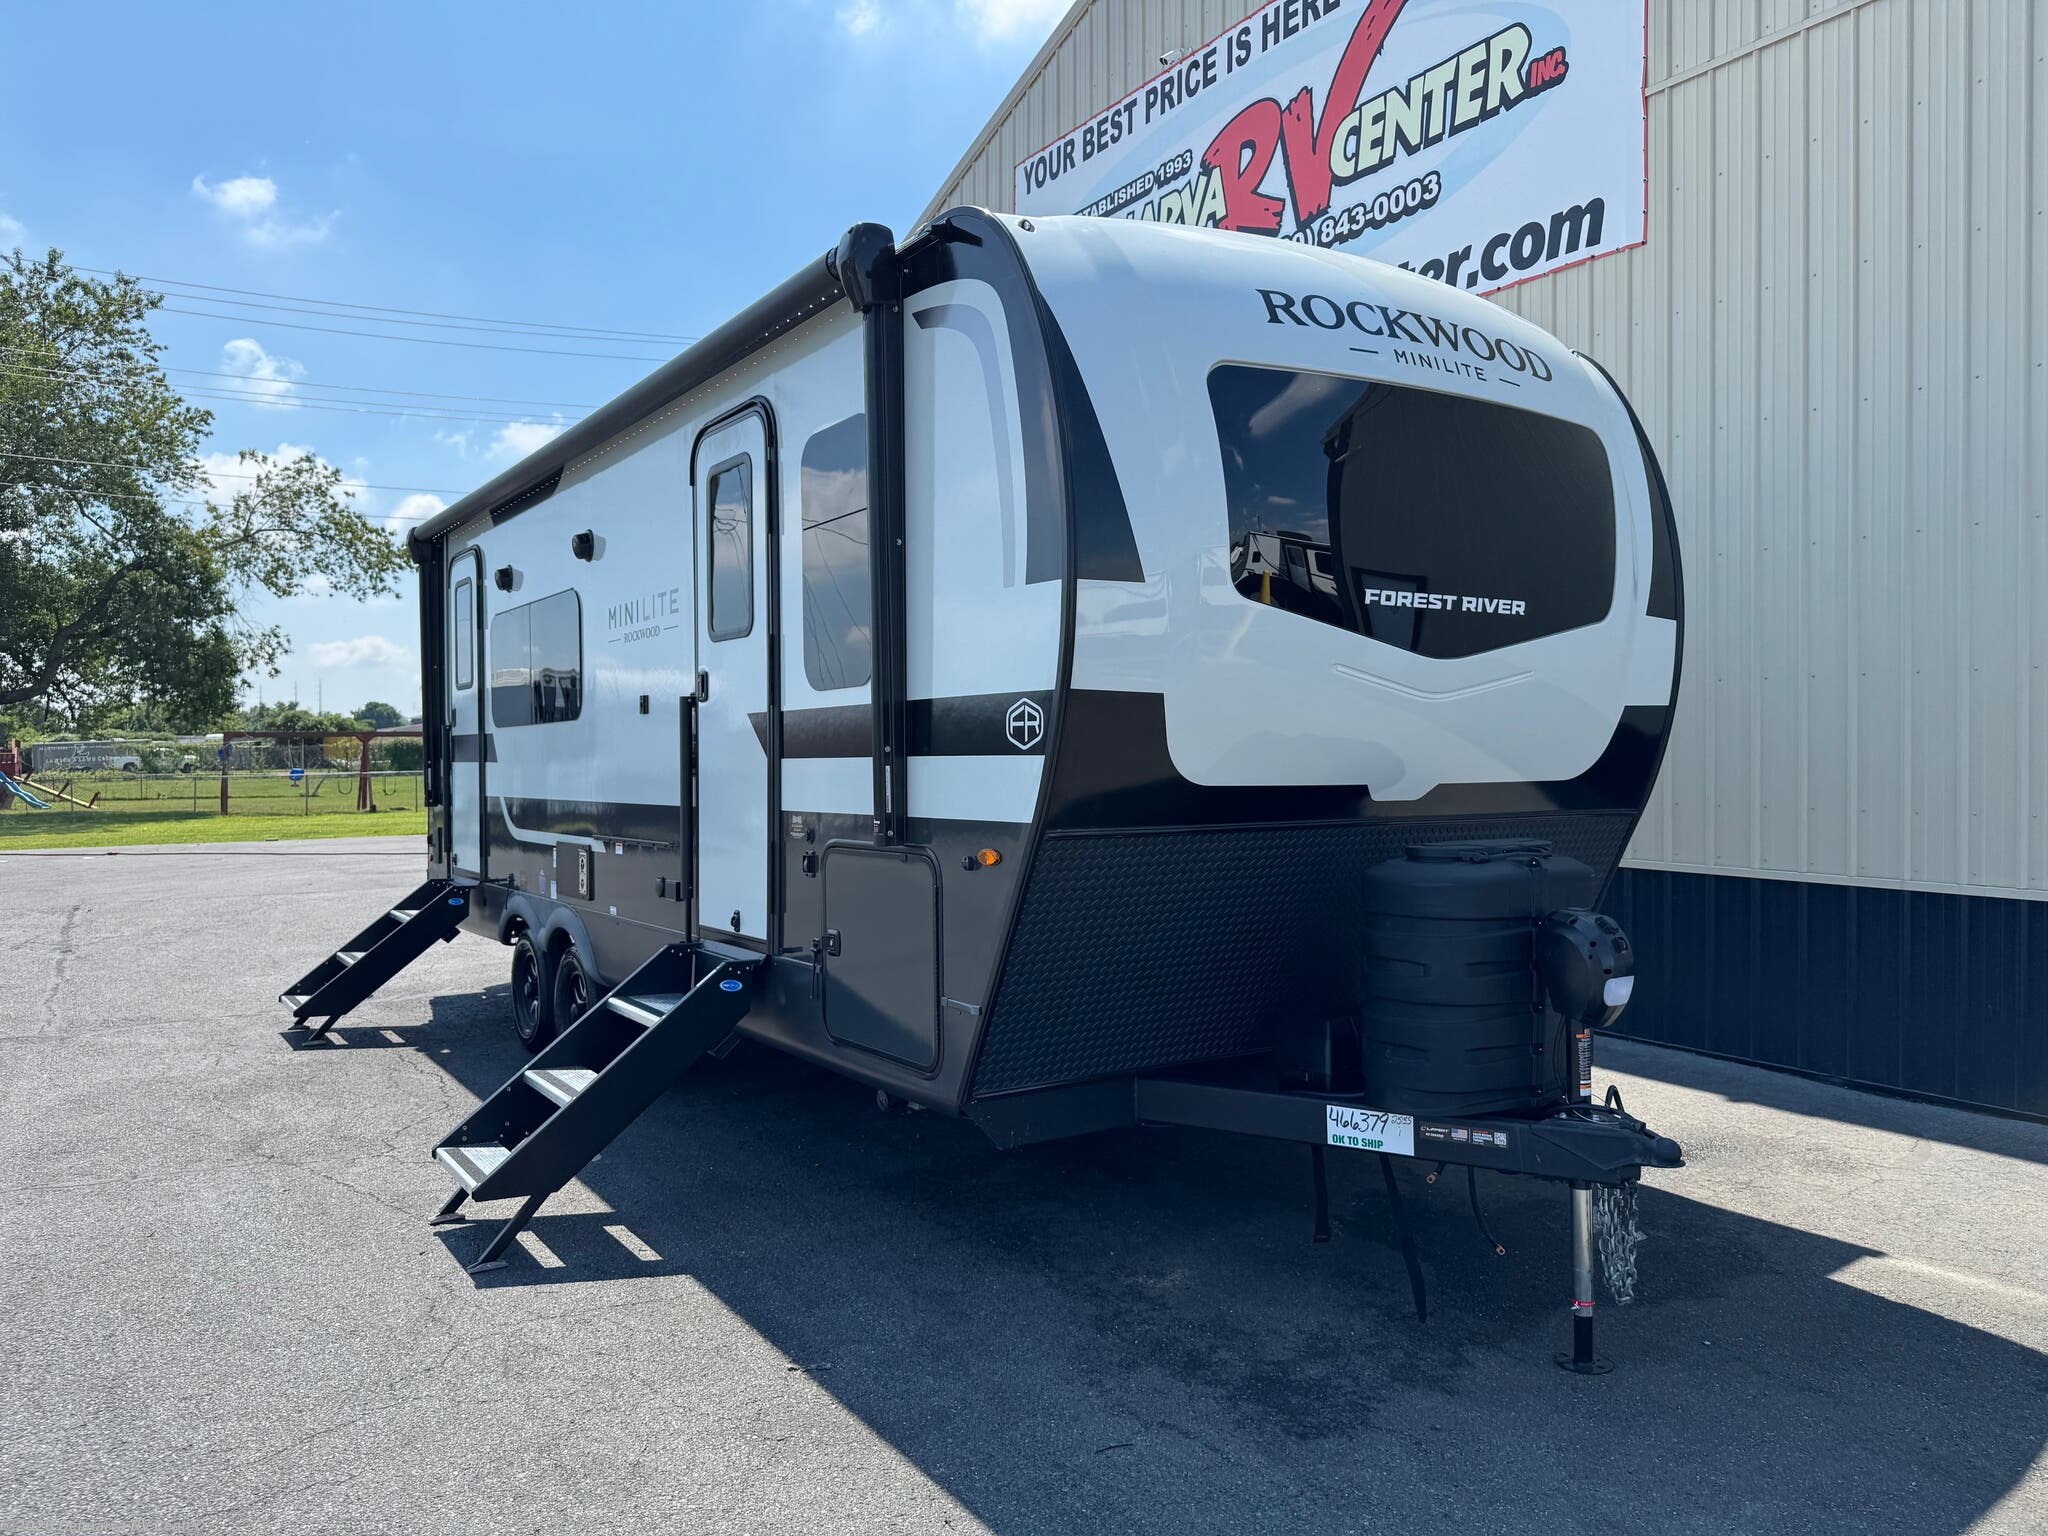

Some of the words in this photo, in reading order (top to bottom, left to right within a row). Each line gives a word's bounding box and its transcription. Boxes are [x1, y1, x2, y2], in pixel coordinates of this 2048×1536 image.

[1023, 138, 1076, 195] YOUR
[1082, 98, 1137, 162] BEST
[1145, 47, 1217, 125] PRICE
[1226, 26, 1251, 75] IS
[1329, 25, 1528, 178] CENTER
[1530, 49, 1566, 88] INC.
[1157, 150, 1193, 184] 1993
[1319, 172, 1440, 244] 843-0003
[1255, 289, 1552, 382] ROCKWOOD
[1394, 349, 1487, 382] MINILITE
[608, 588, 679, 631] MINILITE
[1364, 588, 1457, 610] FOREST
[1462, 596, 1526, 615] RIVER
[624, 625, 660, 643] ROCKWOOD
[1329, 1107, 1389, 1135] 466379
[1332, 1134, 1345, 1145] OK
[1347, 1136, 1358, 1146] TO
[1361, 1138, 1383, 1149] SHIP
